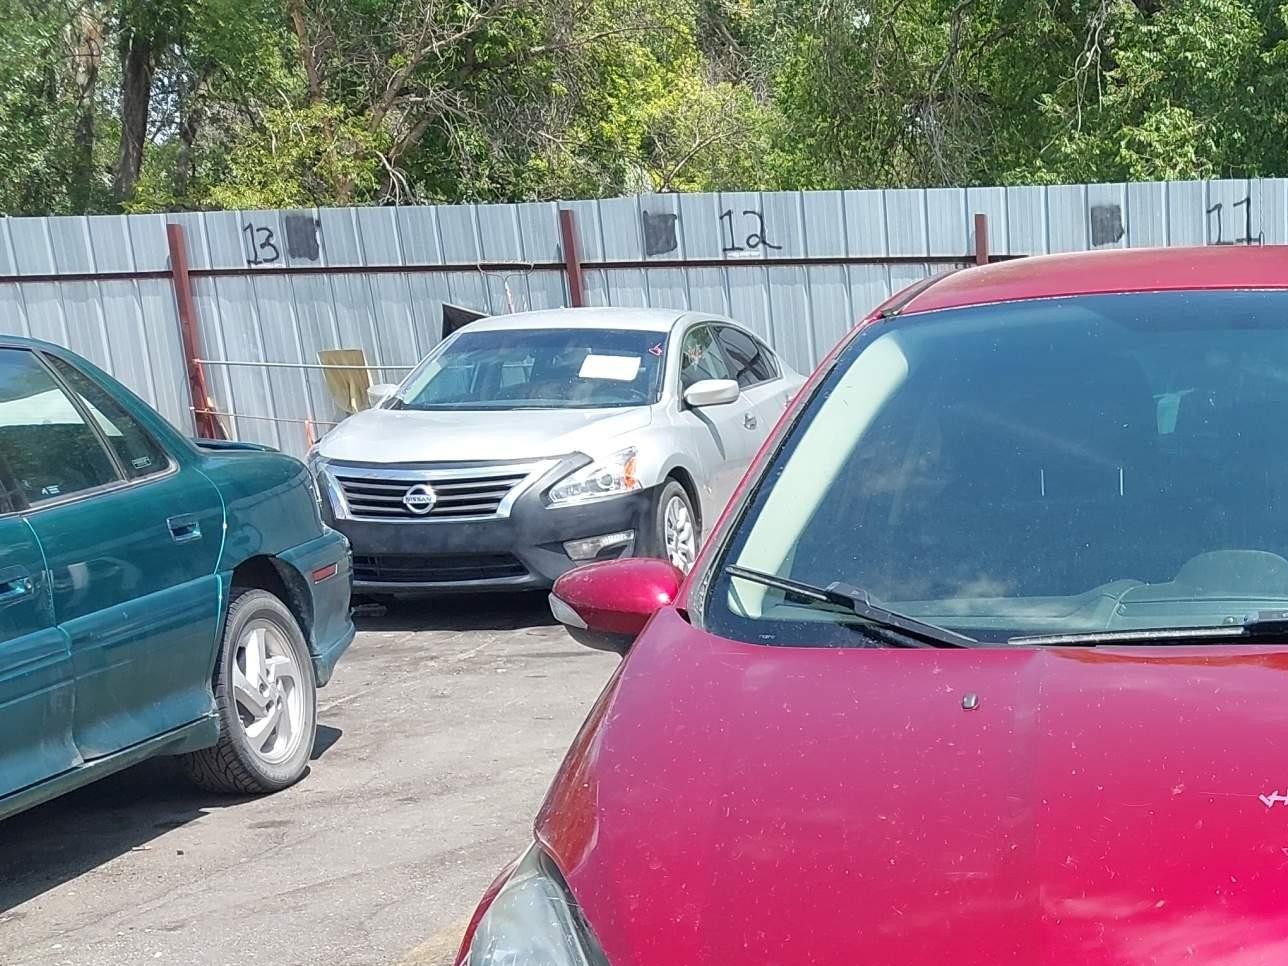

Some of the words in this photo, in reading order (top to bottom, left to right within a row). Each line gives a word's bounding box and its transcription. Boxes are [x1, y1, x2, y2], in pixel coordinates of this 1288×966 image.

[719, 209, 783, 252] 12
[1206, 197, 1262, 245] 11
[243, 222, 279, 265] 13
